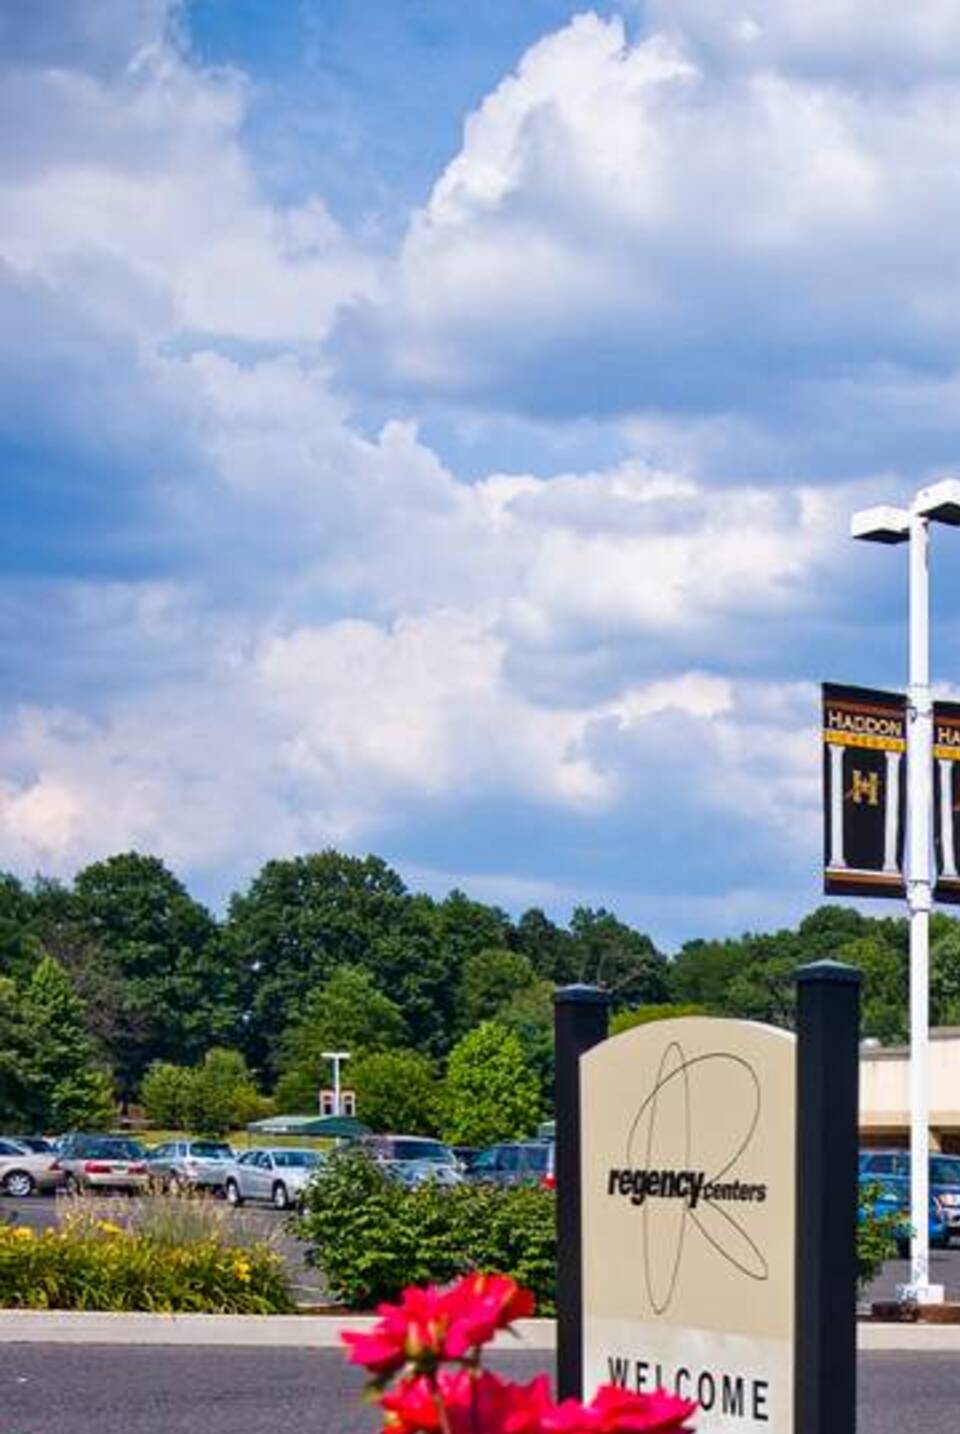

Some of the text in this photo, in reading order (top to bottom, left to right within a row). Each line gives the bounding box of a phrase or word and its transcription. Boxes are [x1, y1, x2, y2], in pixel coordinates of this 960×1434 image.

[828, 711, 902, 735] HADDON
[608, 1169, 767, 1209] regency centers
